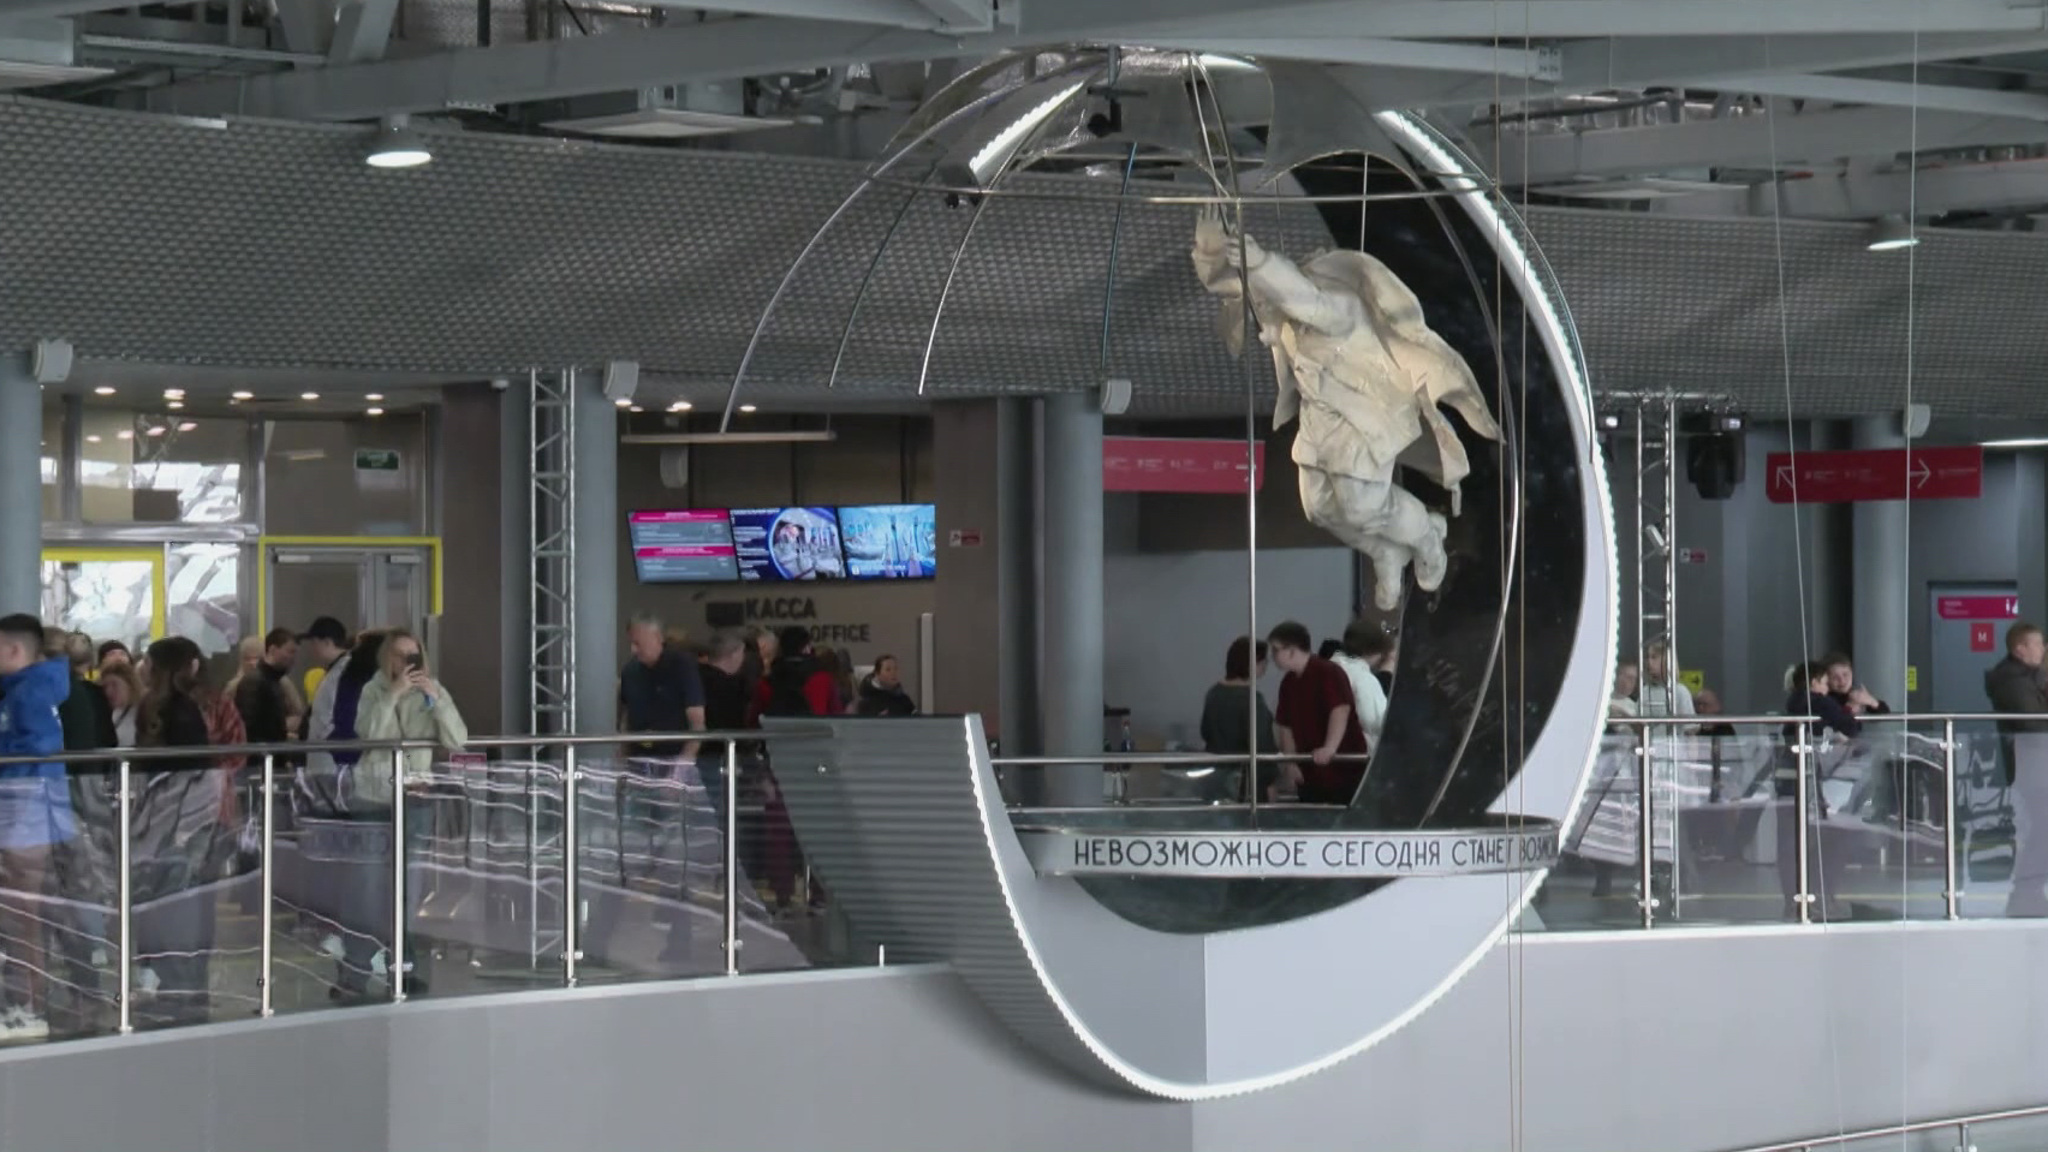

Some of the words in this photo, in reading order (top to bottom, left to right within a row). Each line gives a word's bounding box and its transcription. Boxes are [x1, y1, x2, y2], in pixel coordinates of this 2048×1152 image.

[745, 597, 817, 620] КАССА
[810, 623, 871, 642] OFFICE
[1074, 838, 1308, 868] НЕВОЗМОЖНОЕ
[1321, 840, 1441, 872] СЕГОДНЯ
[1451, 838, 1514, 866] СТАНЕТ
